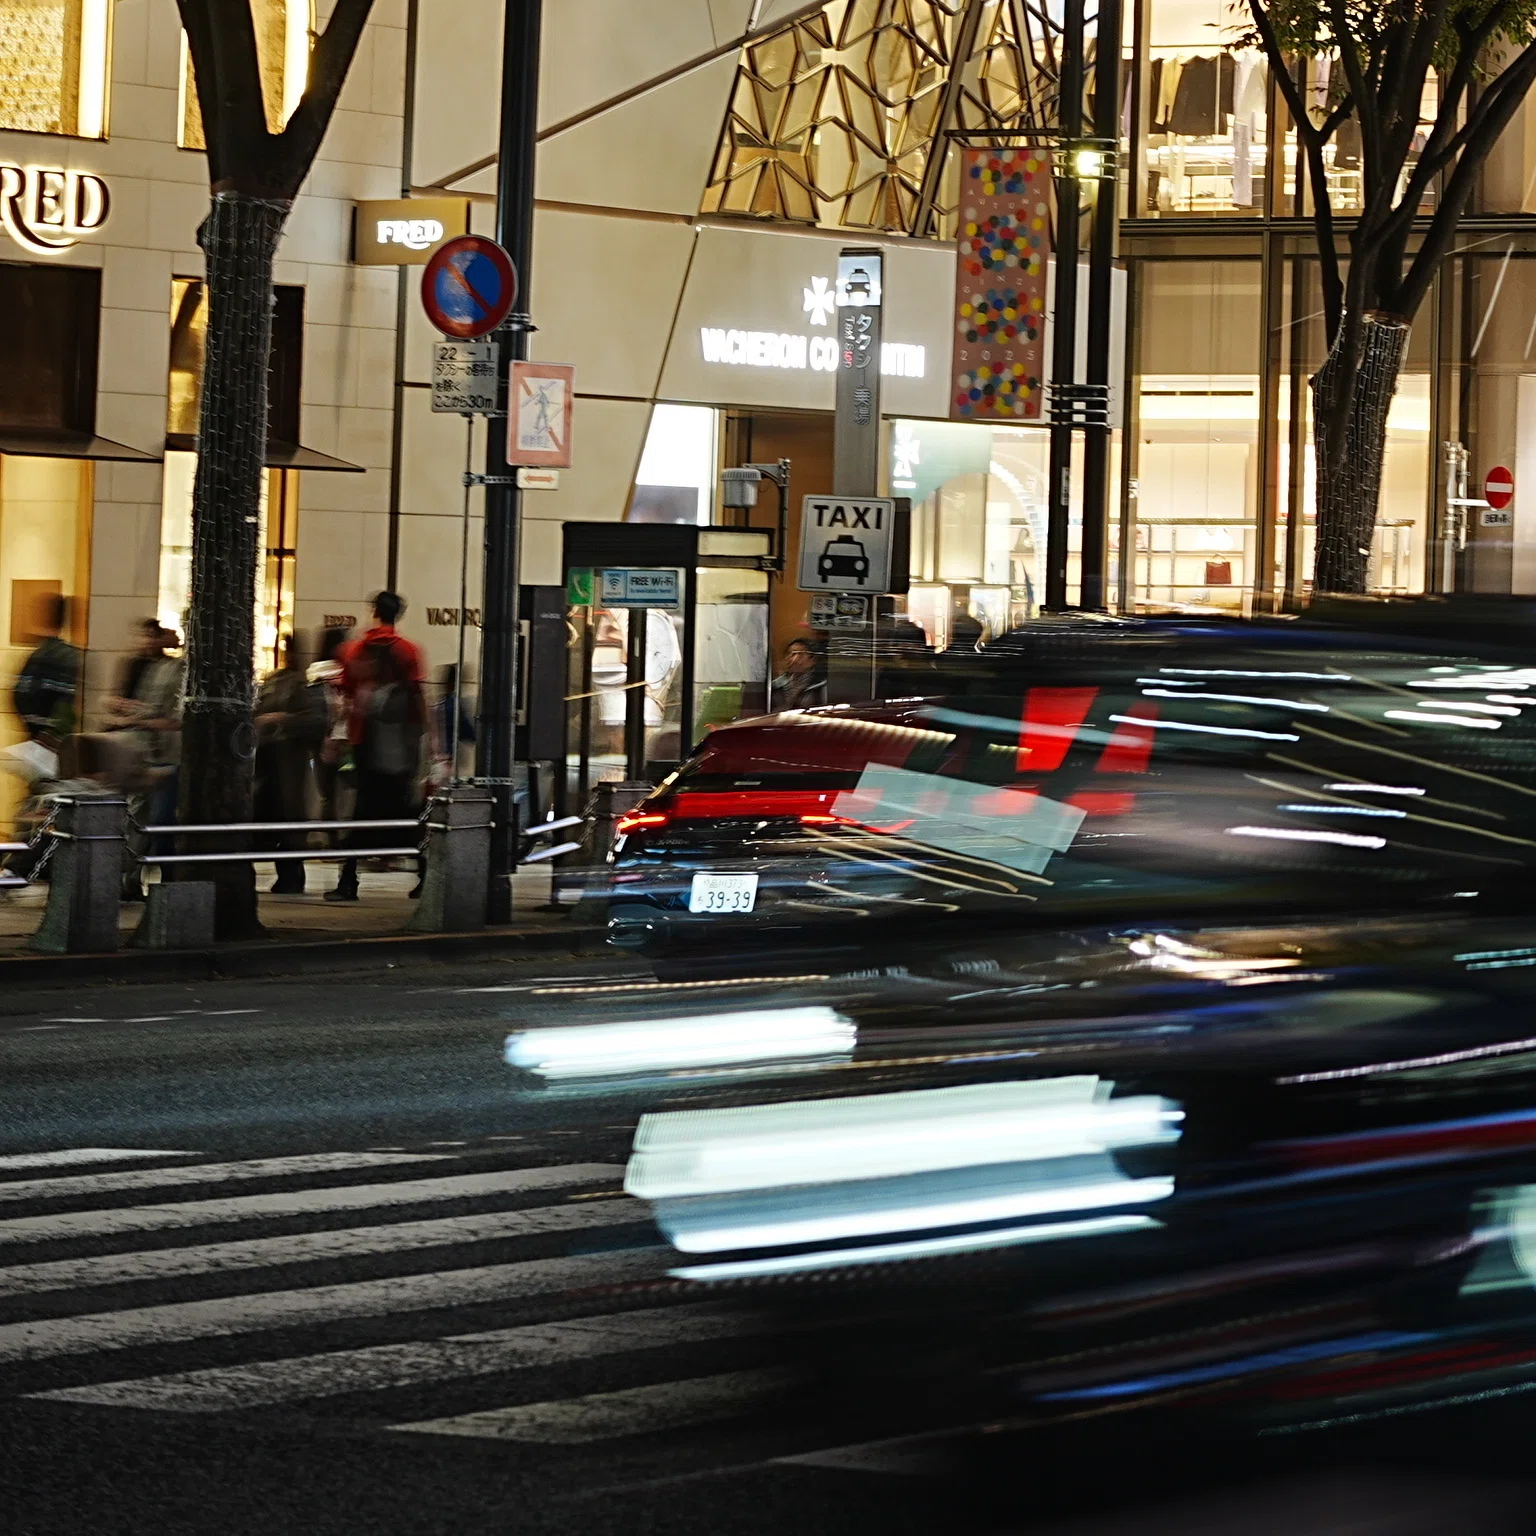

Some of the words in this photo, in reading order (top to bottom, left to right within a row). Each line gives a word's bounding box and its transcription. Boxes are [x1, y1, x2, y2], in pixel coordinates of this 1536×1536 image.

[376, 219, 444, 248] FRED
[439, 347, 457, 360] 22
[486, 346, 492, 360] 1
[701, 327, 807, 369] VACHERON
[809, 336, 925, 378] CONTIN
[959, 349, 1036, 361] 2025
[434, 395, 494, 409] ここから30m
[812, 504, 883, 530] TAXI
[630, 576, 650, 585] FREE
[426, 607, 481, 627] VACHRO
[706, 891, 751, 909] 39-39
